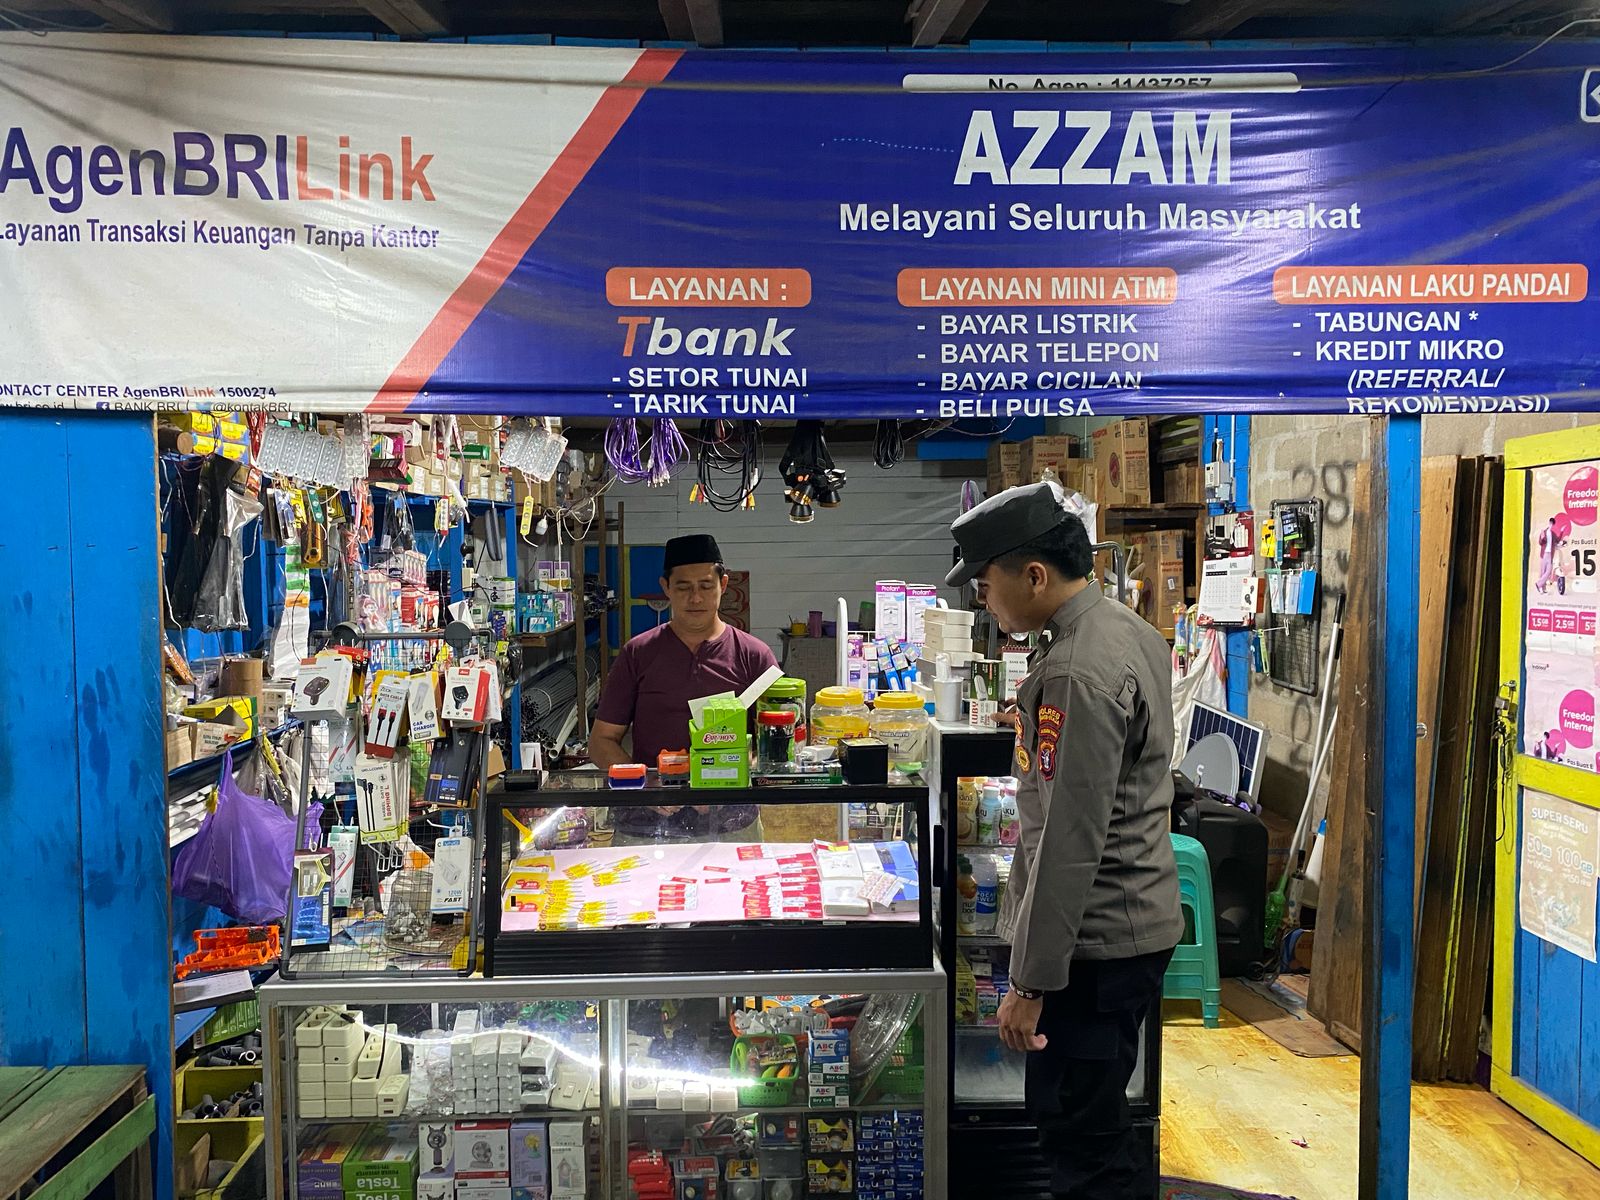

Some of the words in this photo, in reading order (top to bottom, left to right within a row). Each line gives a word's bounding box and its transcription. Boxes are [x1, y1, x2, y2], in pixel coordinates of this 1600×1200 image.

[953, 109, 1233, 186] AZZAM
[0, 127, 436, 213] AgenBRILink
[840, 203, 997, 238] Melayani
[1008, 203, 1147, 232] Seluruh
[1159, 202, 1362, 237] Masyarakat
[0, 222, 80, 246] ayanan
[86, 218, 187, 244] Transaksi
[192, 219, 296, 250] Keuangan
[303, 224, 365, 251] Tanpa
[371, 224, 440, 249] Kantor
[628, 276, 771, 301] LAYANAN
[920, 277, 1043, 300] LAYANAN
[1050, 277, 1107, 300] MINI
[1111, 277, 1168, 300] ATM
[1291, 275, 1403, 299] LAYANAN
[1408, 275, 1476, 298] LAKU
[1482, 272, 1571, 297] PANDAI
[939, 313, 1029, 335] BAYAR
[1036, 313, 1138, 335] LISTRIK
[1315, 311, 1462, 333] TABUNGAN
[616, 315, 796, 357] Tbank
[939, 342, 1029, 364] BAYAR
[1037, 342, 1160, 363] TELEPON
[1315, 340, 1413, 362] KREDIT
[1417, 340, 1505, 361] MIKRO
[627, 367, 721, 389] SETOR
[727, 367, 808, 388] TUNAI
[939, 371, 1029, 392] BAYAR
[1036, 370, 1142, 391] CICILAN
[1347, 367, 1506, 394] (REFERRAL/
[0, 384, 52, 396] NTACT
[56, 385, 119, 397] CENTER
[122, 386, 216, 400] AgenBRILink
[218, 387, 277, 400] 1500274
[629, 393, 711, 415] TARIK
[716, 393, 796, 414] TUNAI
[938, 399, 999, 417] BELI
[1007, 398, 1095, 417] PULSA
[1346, 394, 1551, 414] REKOMENDASI)
[413, 723, 436, 732] CHARGER
[1531, 807, 1563, 823] SUPER
[816, 1042, 834, 1050] ABC
[356, 1177, 401, 1190] Tesla
